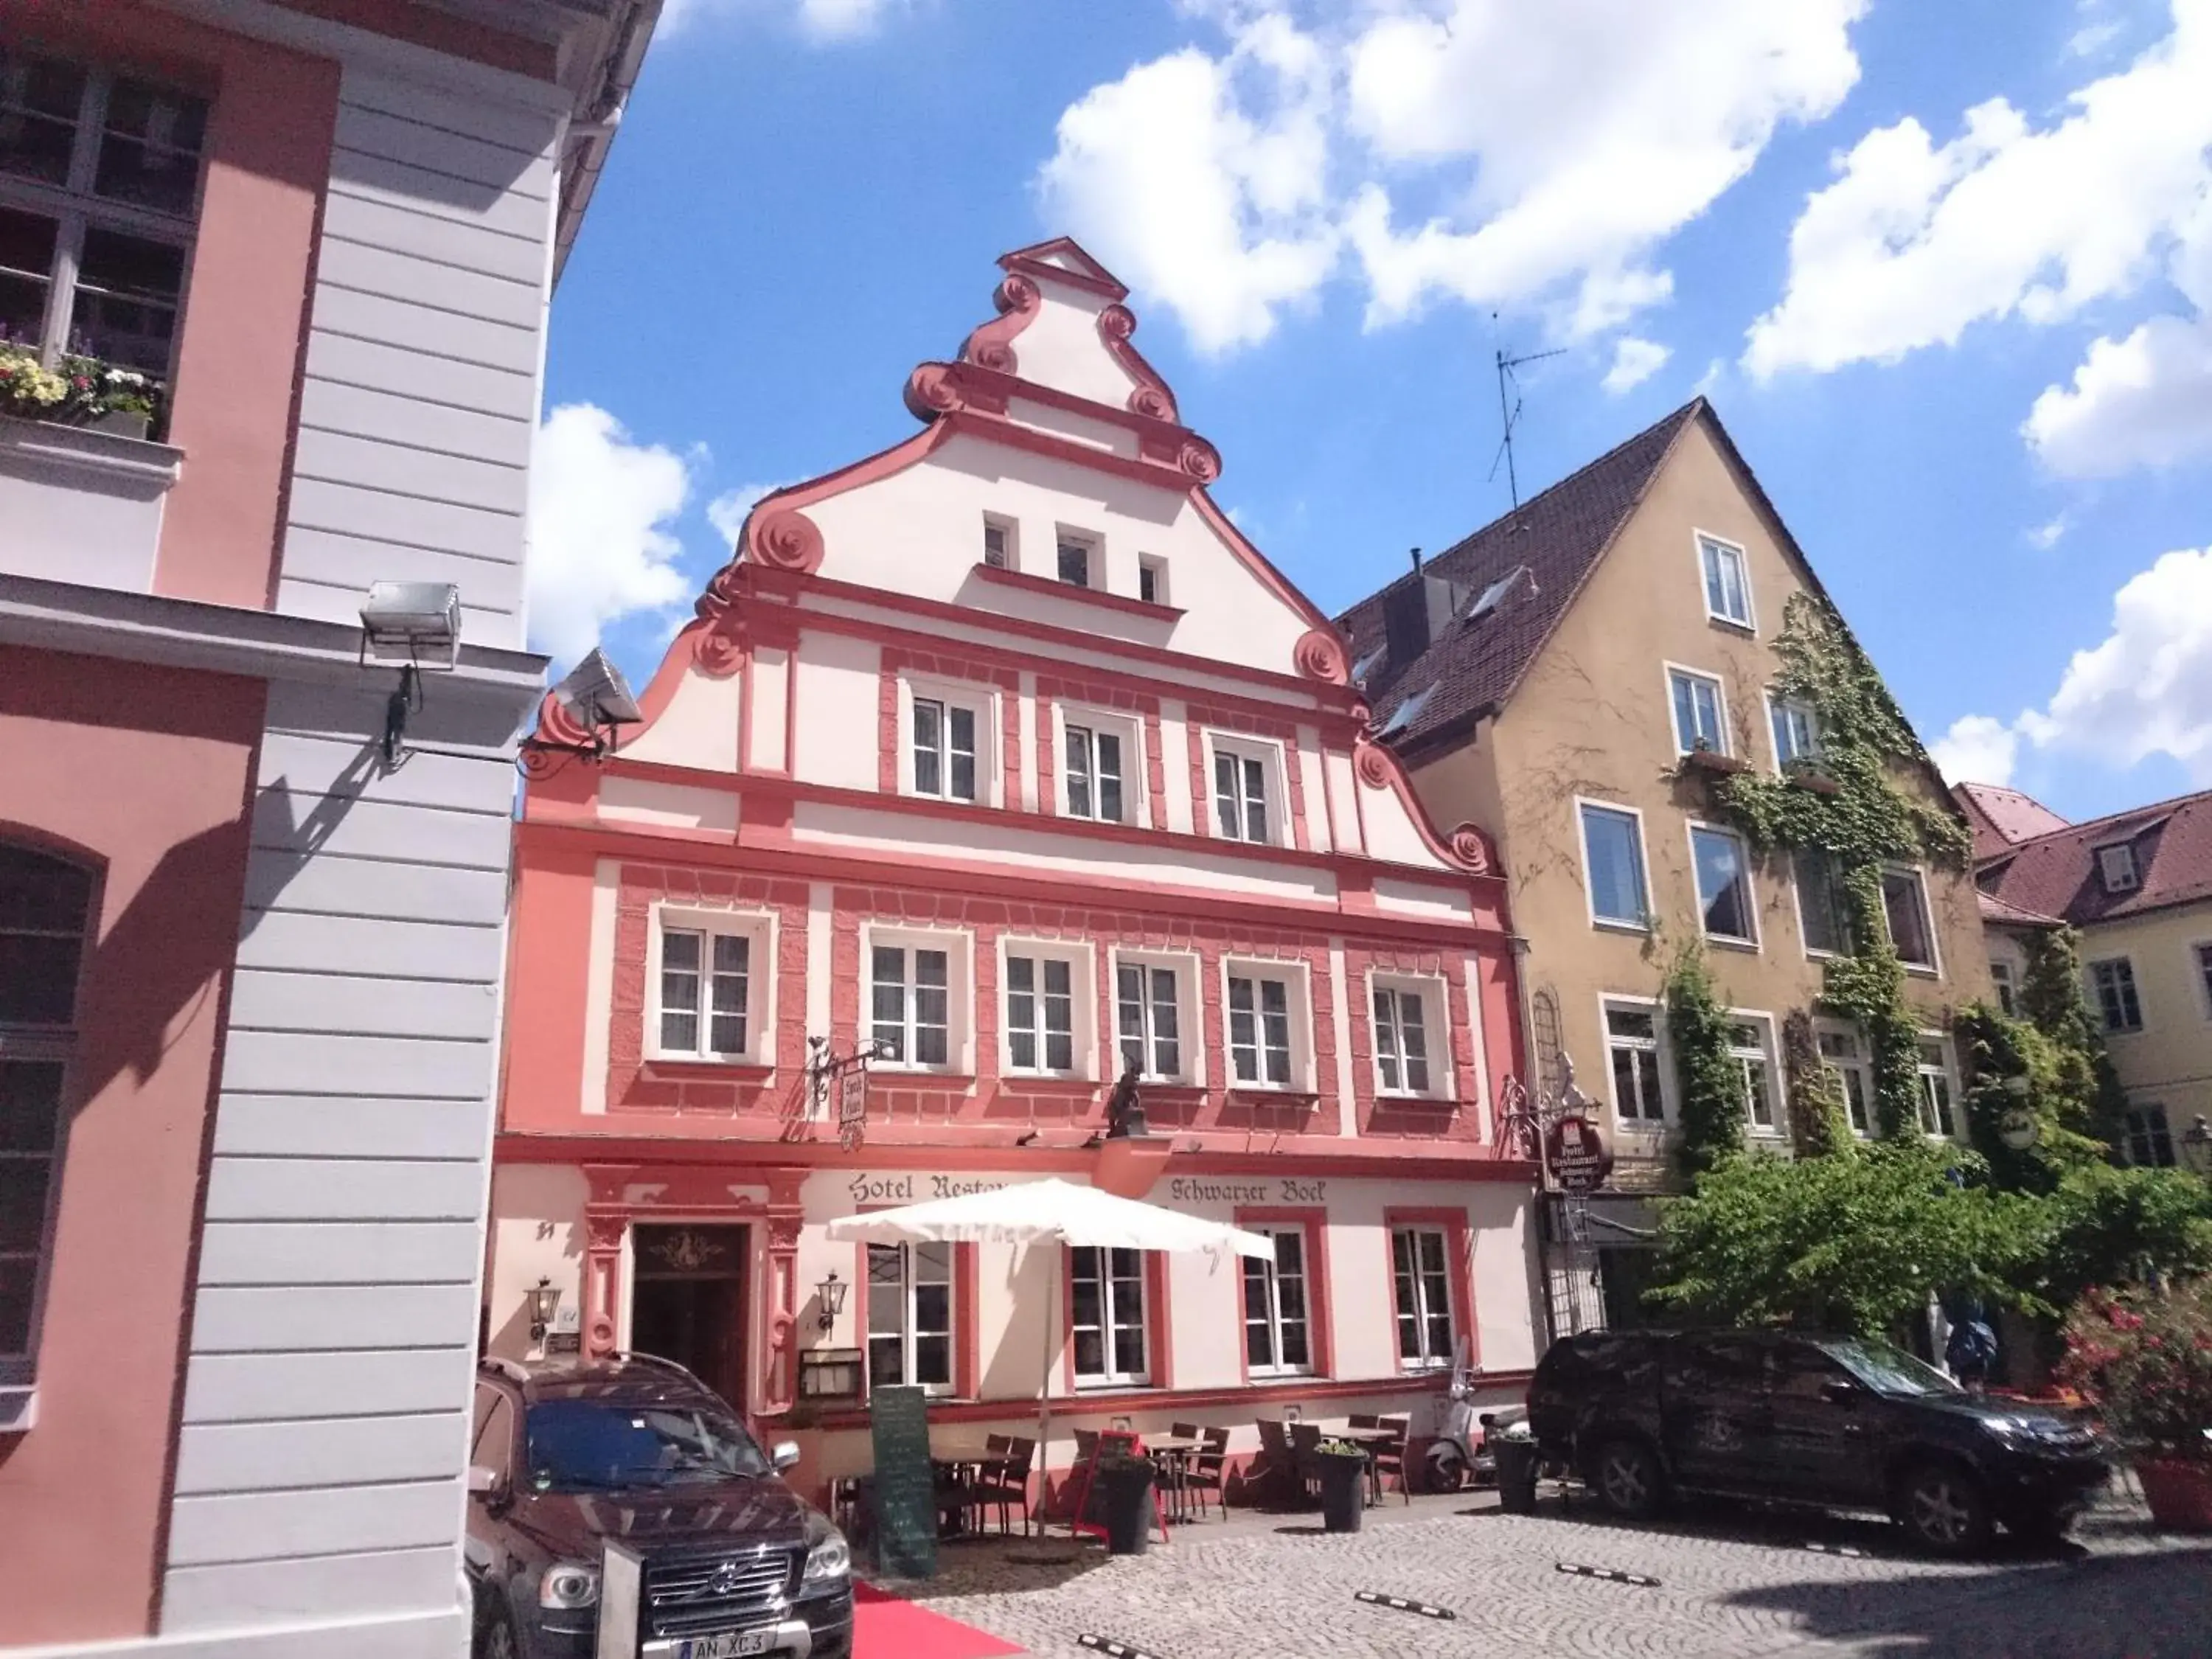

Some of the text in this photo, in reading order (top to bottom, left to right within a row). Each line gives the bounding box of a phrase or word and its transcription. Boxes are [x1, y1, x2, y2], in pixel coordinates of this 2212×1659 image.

[849, 1173, 914, 1202] Hotel
[1171, 1178, 1326, 1203] Schwarzer Bock
[695, 1638, 718, 1658] AN
